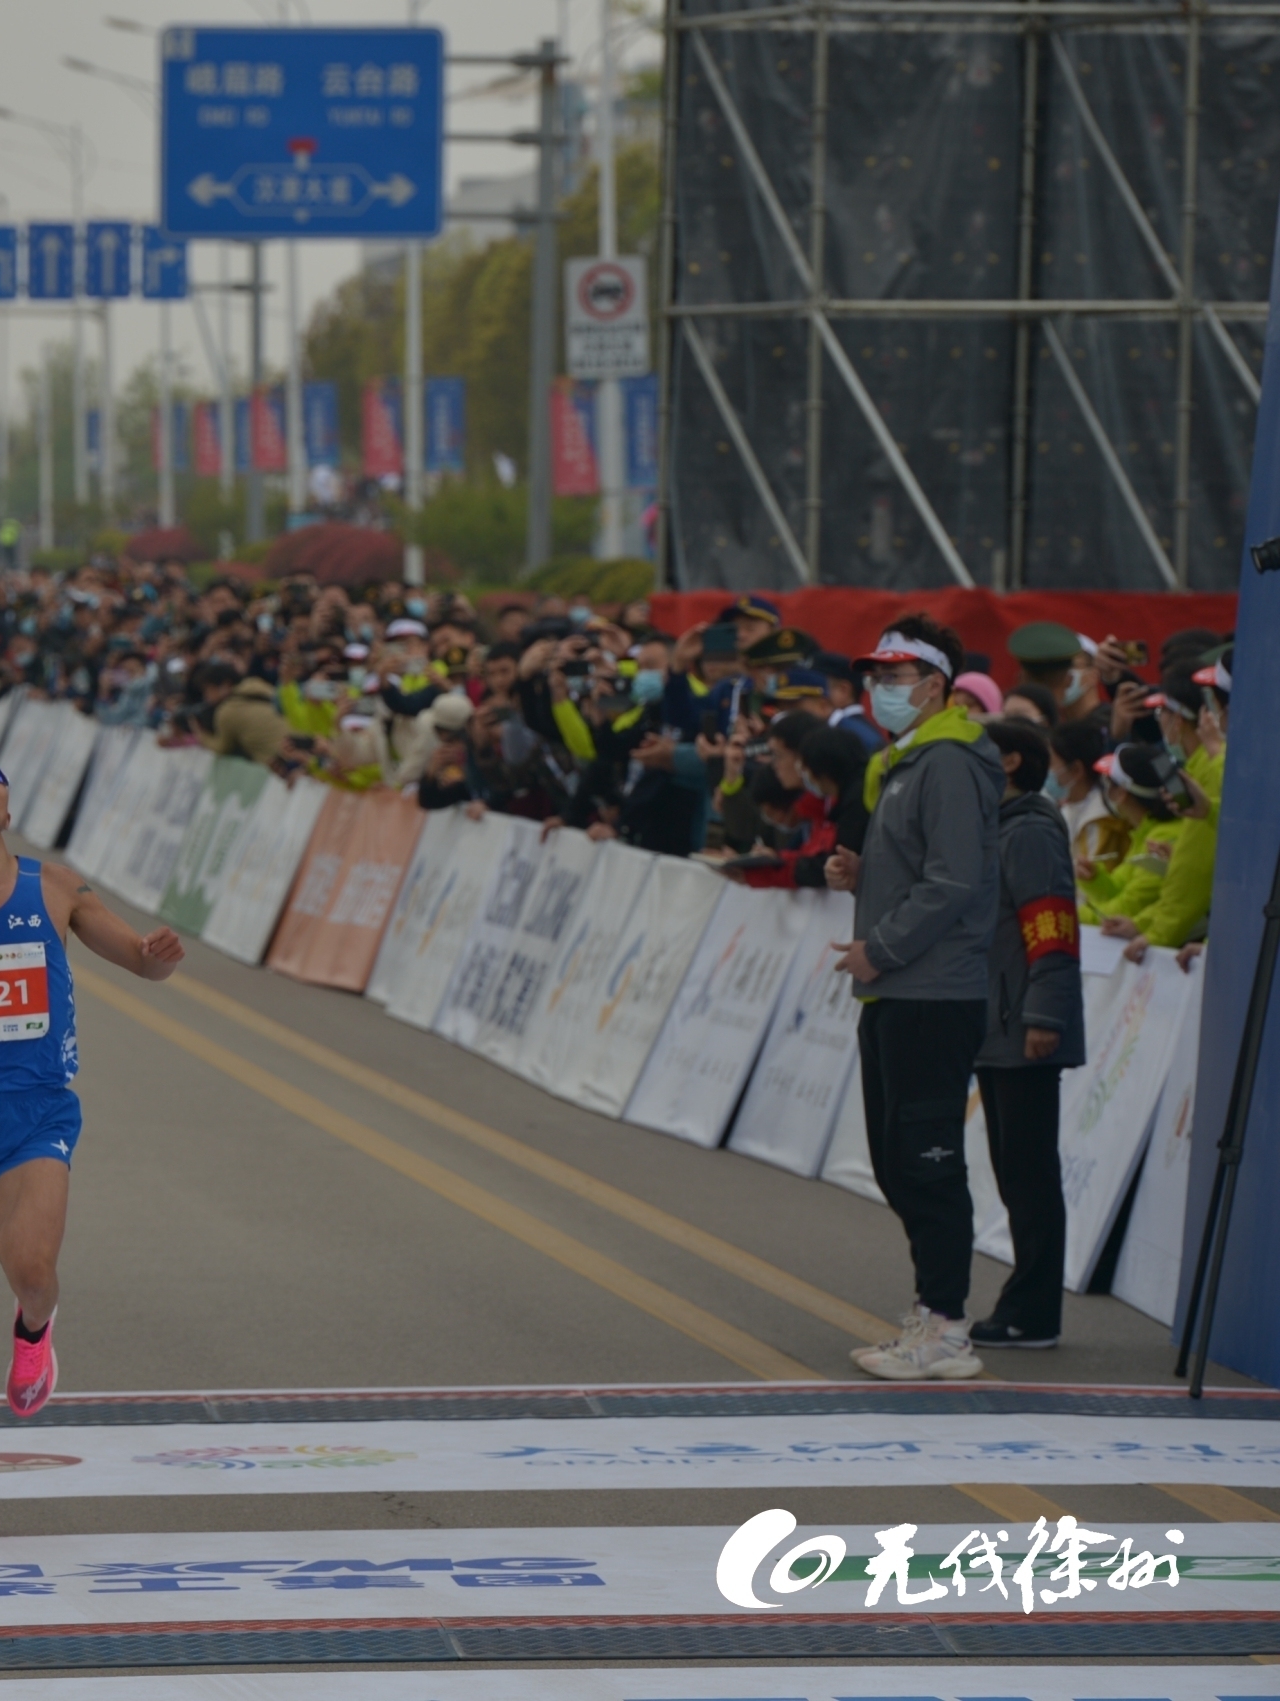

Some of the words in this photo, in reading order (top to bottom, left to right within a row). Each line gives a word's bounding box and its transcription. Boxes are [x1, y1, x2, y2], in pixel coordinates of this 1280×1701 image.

[8, 914, 41, 930] 江西
[523, 1458, 716, 1467] GRAND
[730, 1456, 917, 1464] CANAL
[50, 1557, 597, 1578] XCMG
